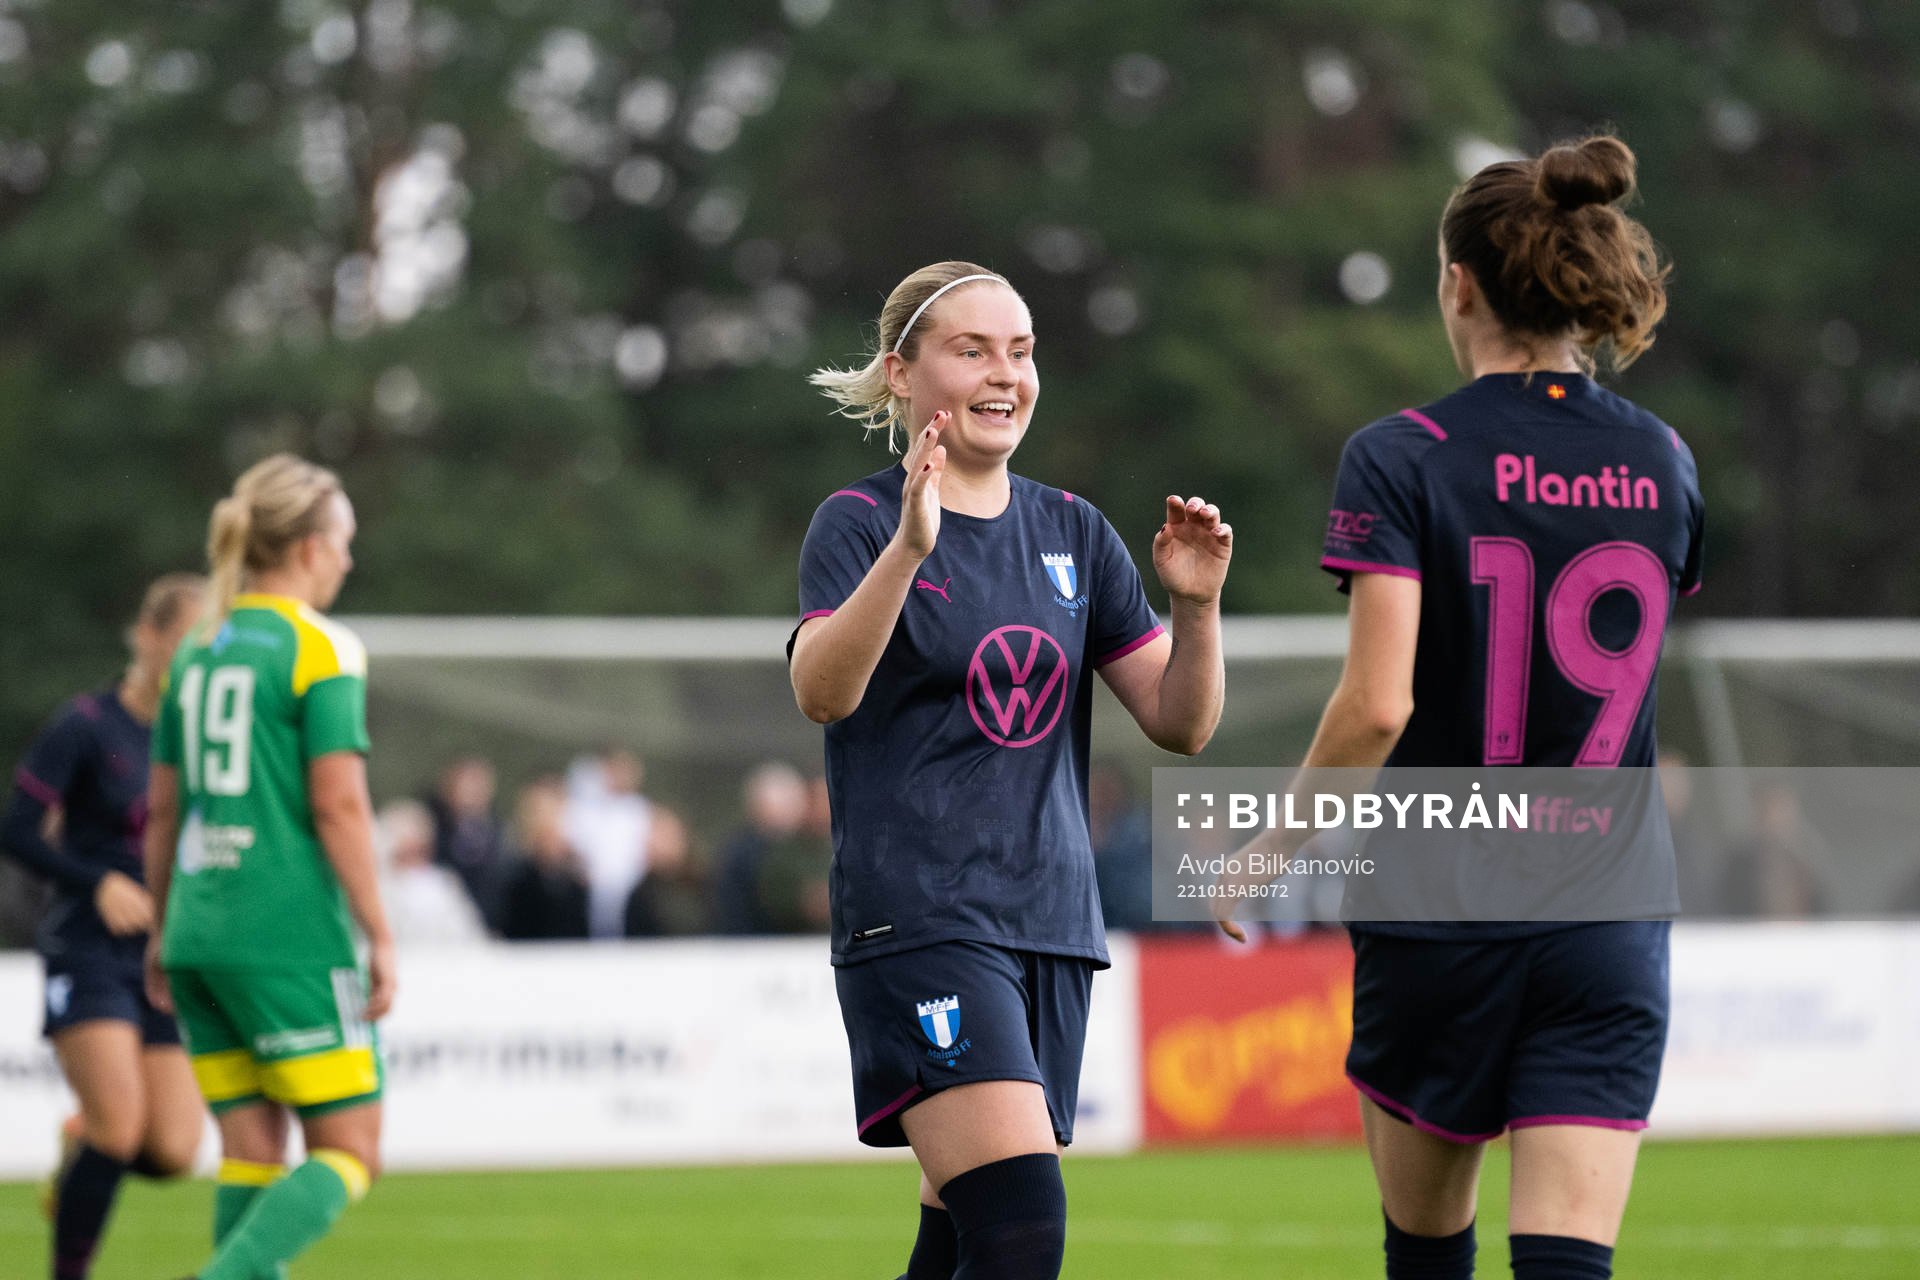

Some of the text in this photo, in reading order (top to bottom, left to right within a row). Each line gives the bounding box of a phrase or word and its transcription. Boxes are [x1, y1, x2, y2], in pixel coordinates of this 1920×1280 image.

[1494, 453, 1659, 509] Plantin
[1054, 594, 1079, 609] Malmö
[1470, 536, 1669, 768] 19
[179, 664, 255, 797] 19
[927, 1038, 972, 1060] Malmö FF
